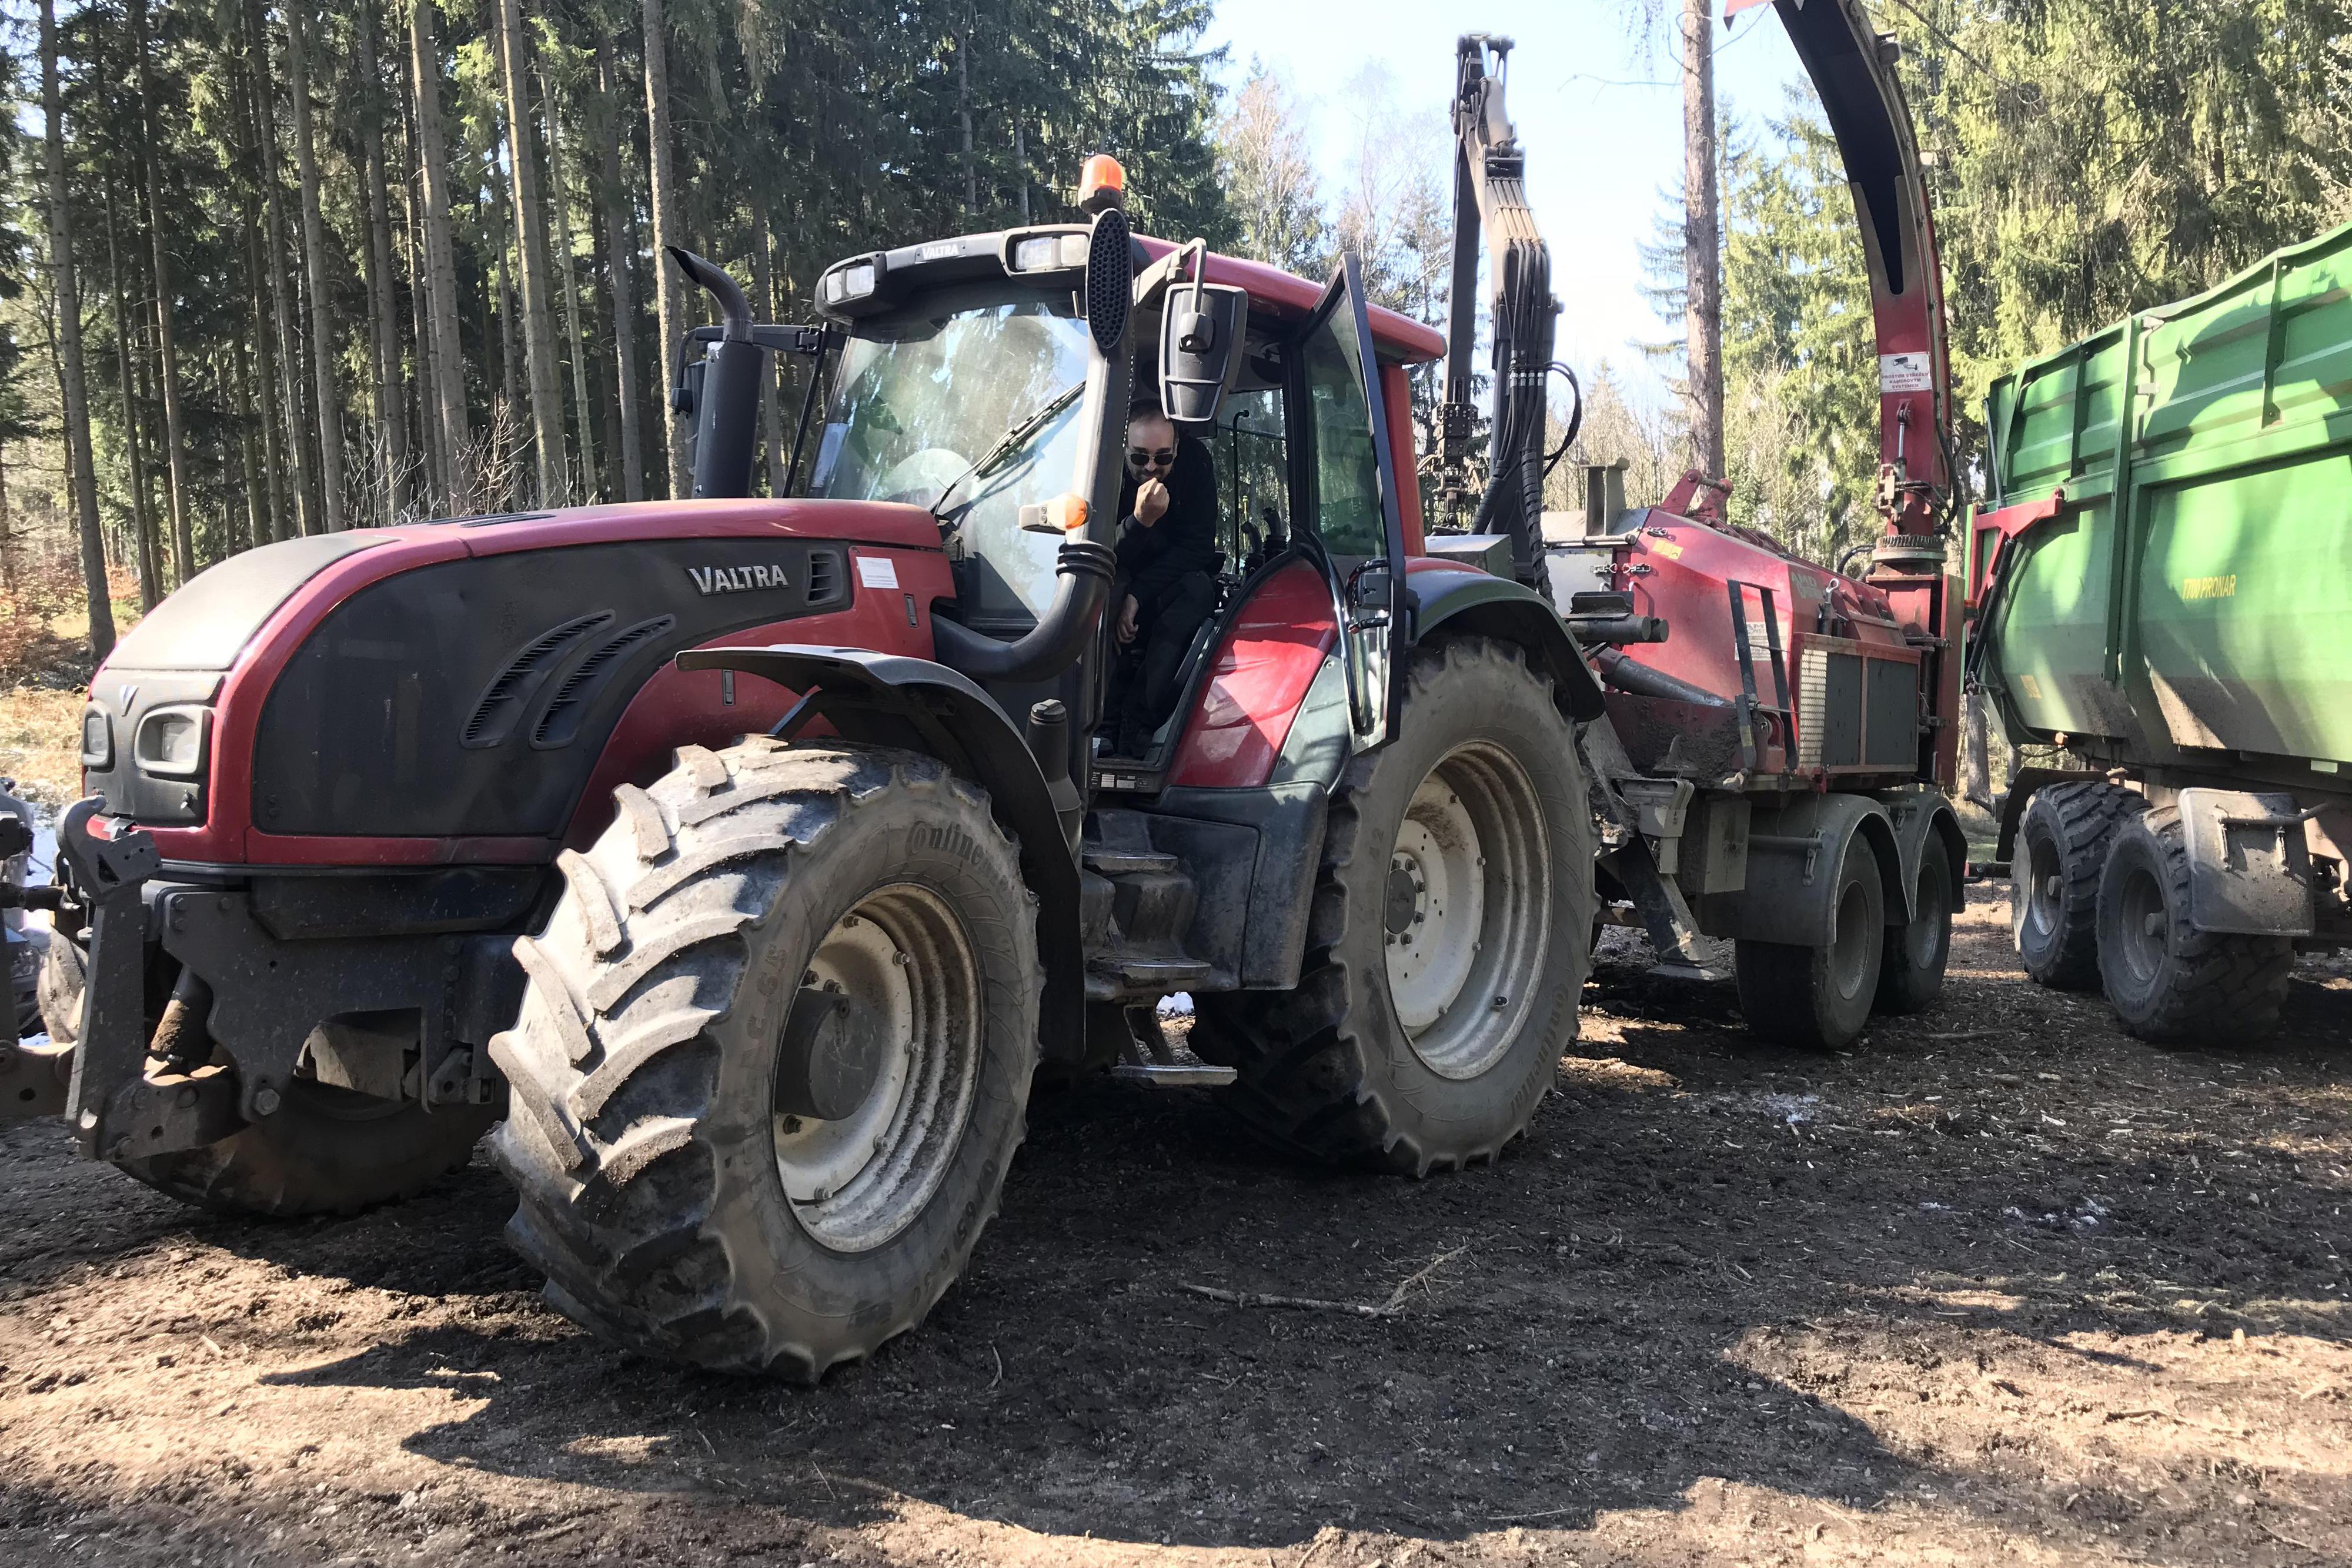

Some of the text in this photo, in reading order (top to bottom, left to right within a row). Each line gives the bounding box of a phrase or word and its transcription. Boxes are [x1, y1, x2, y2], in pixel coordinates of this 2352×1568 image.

[922, 244, 960, 259] VALTRA
[688, 564, 789, 594] VALTRA
[2200, 574, 2236, 599] PRONAR
